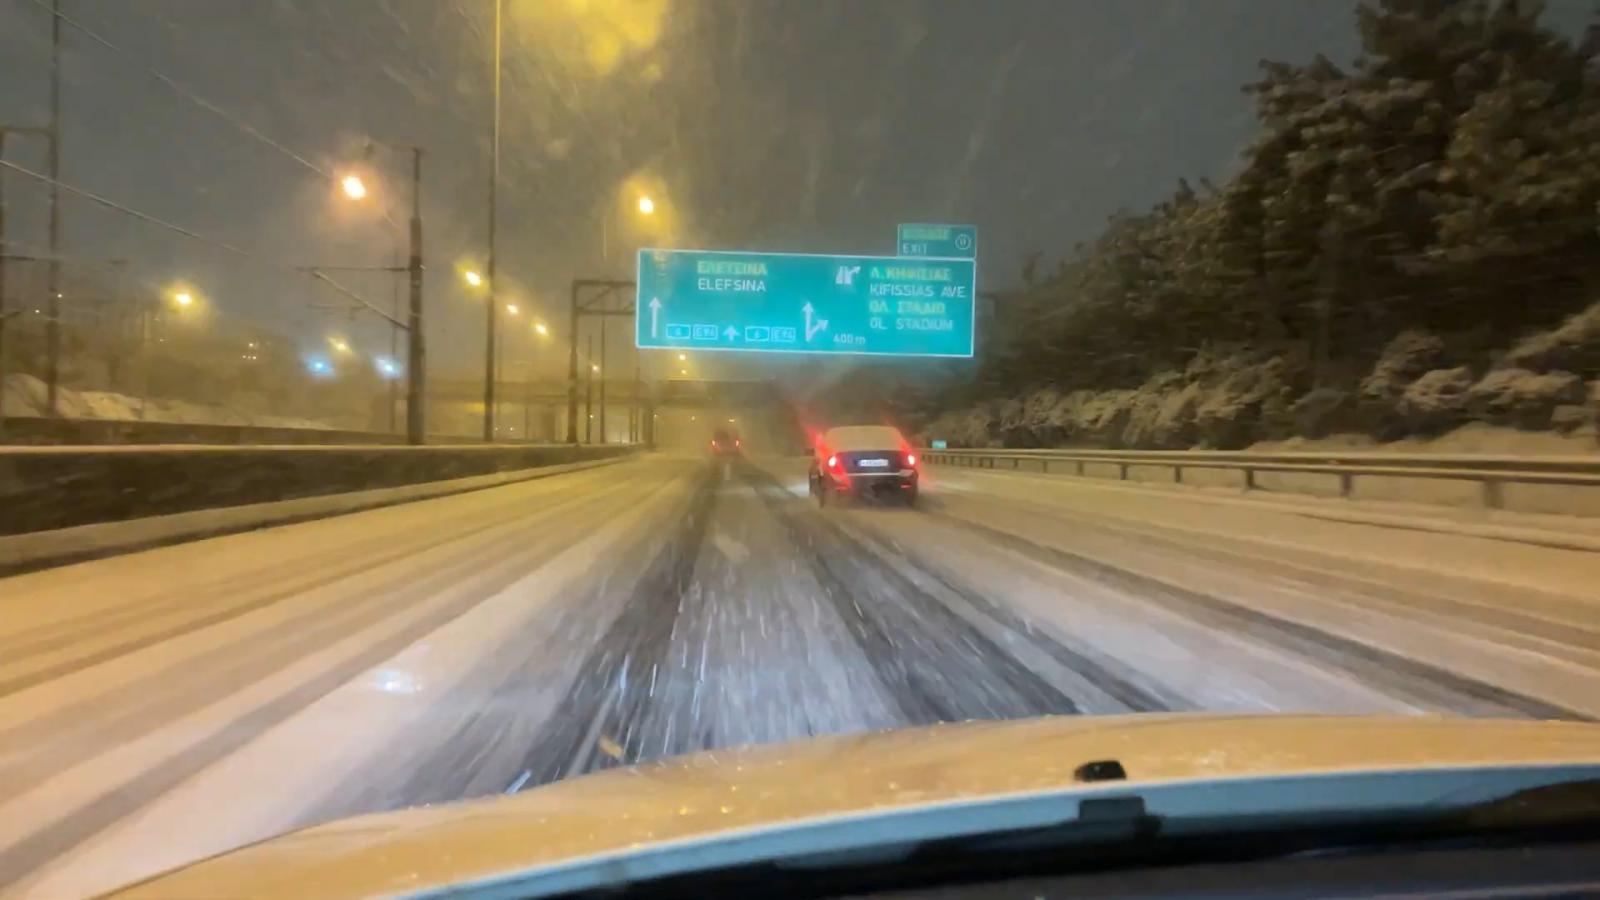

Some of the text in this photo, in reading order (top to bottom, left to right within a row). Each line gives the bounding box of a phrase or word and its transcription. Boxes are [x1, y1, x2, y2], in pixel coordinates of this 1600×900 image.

[903, 243, 927, 254] EXIT
[698, 278, 767, 291] ELEFSINA
[870, 283, 966, 298] KIFISSIAS AVE
[896, 318, 953, 331] STADIUM
